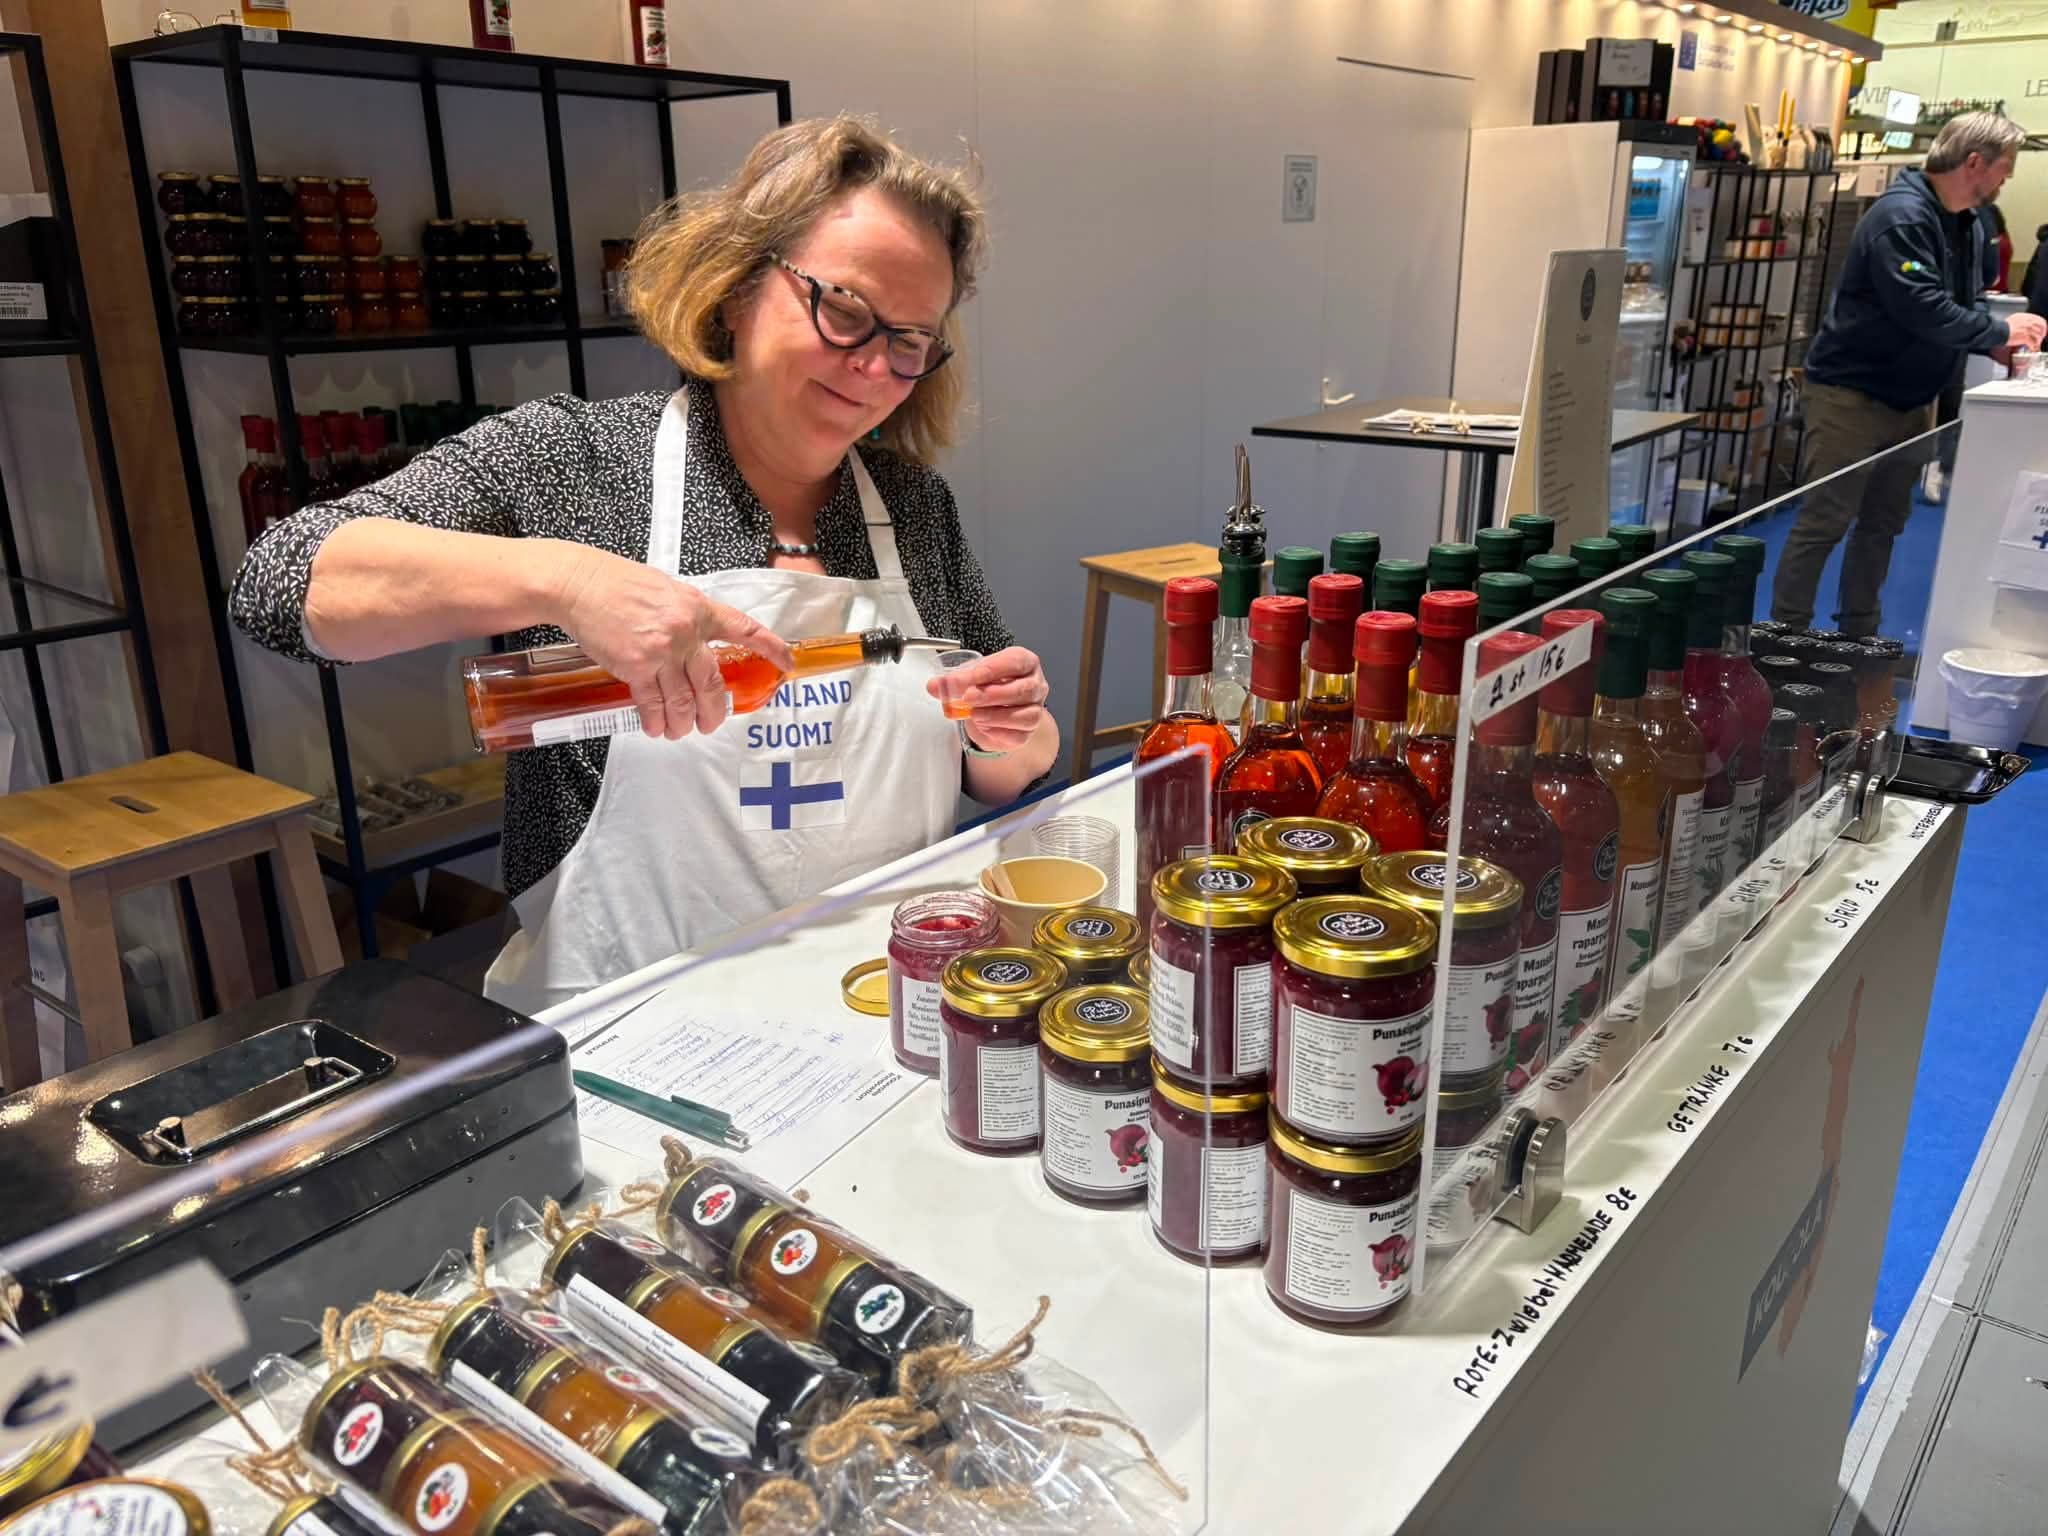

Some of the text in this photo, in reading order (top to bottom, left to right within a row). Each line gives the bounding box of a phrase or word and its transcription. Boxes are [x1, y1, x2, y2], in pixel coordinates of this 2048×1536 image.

[766, 680, 852, 709] NLAND
[747, 720, 833, 749] SUOMI
[1824, 878, 1880, 929] SIRUP 5€
[1104, 1094, 1151, 1111] Punasipu
[1666, 1064, 1731, 1133] GETRÄNKE
[1605, 1186, 1638, 1212] 8€
